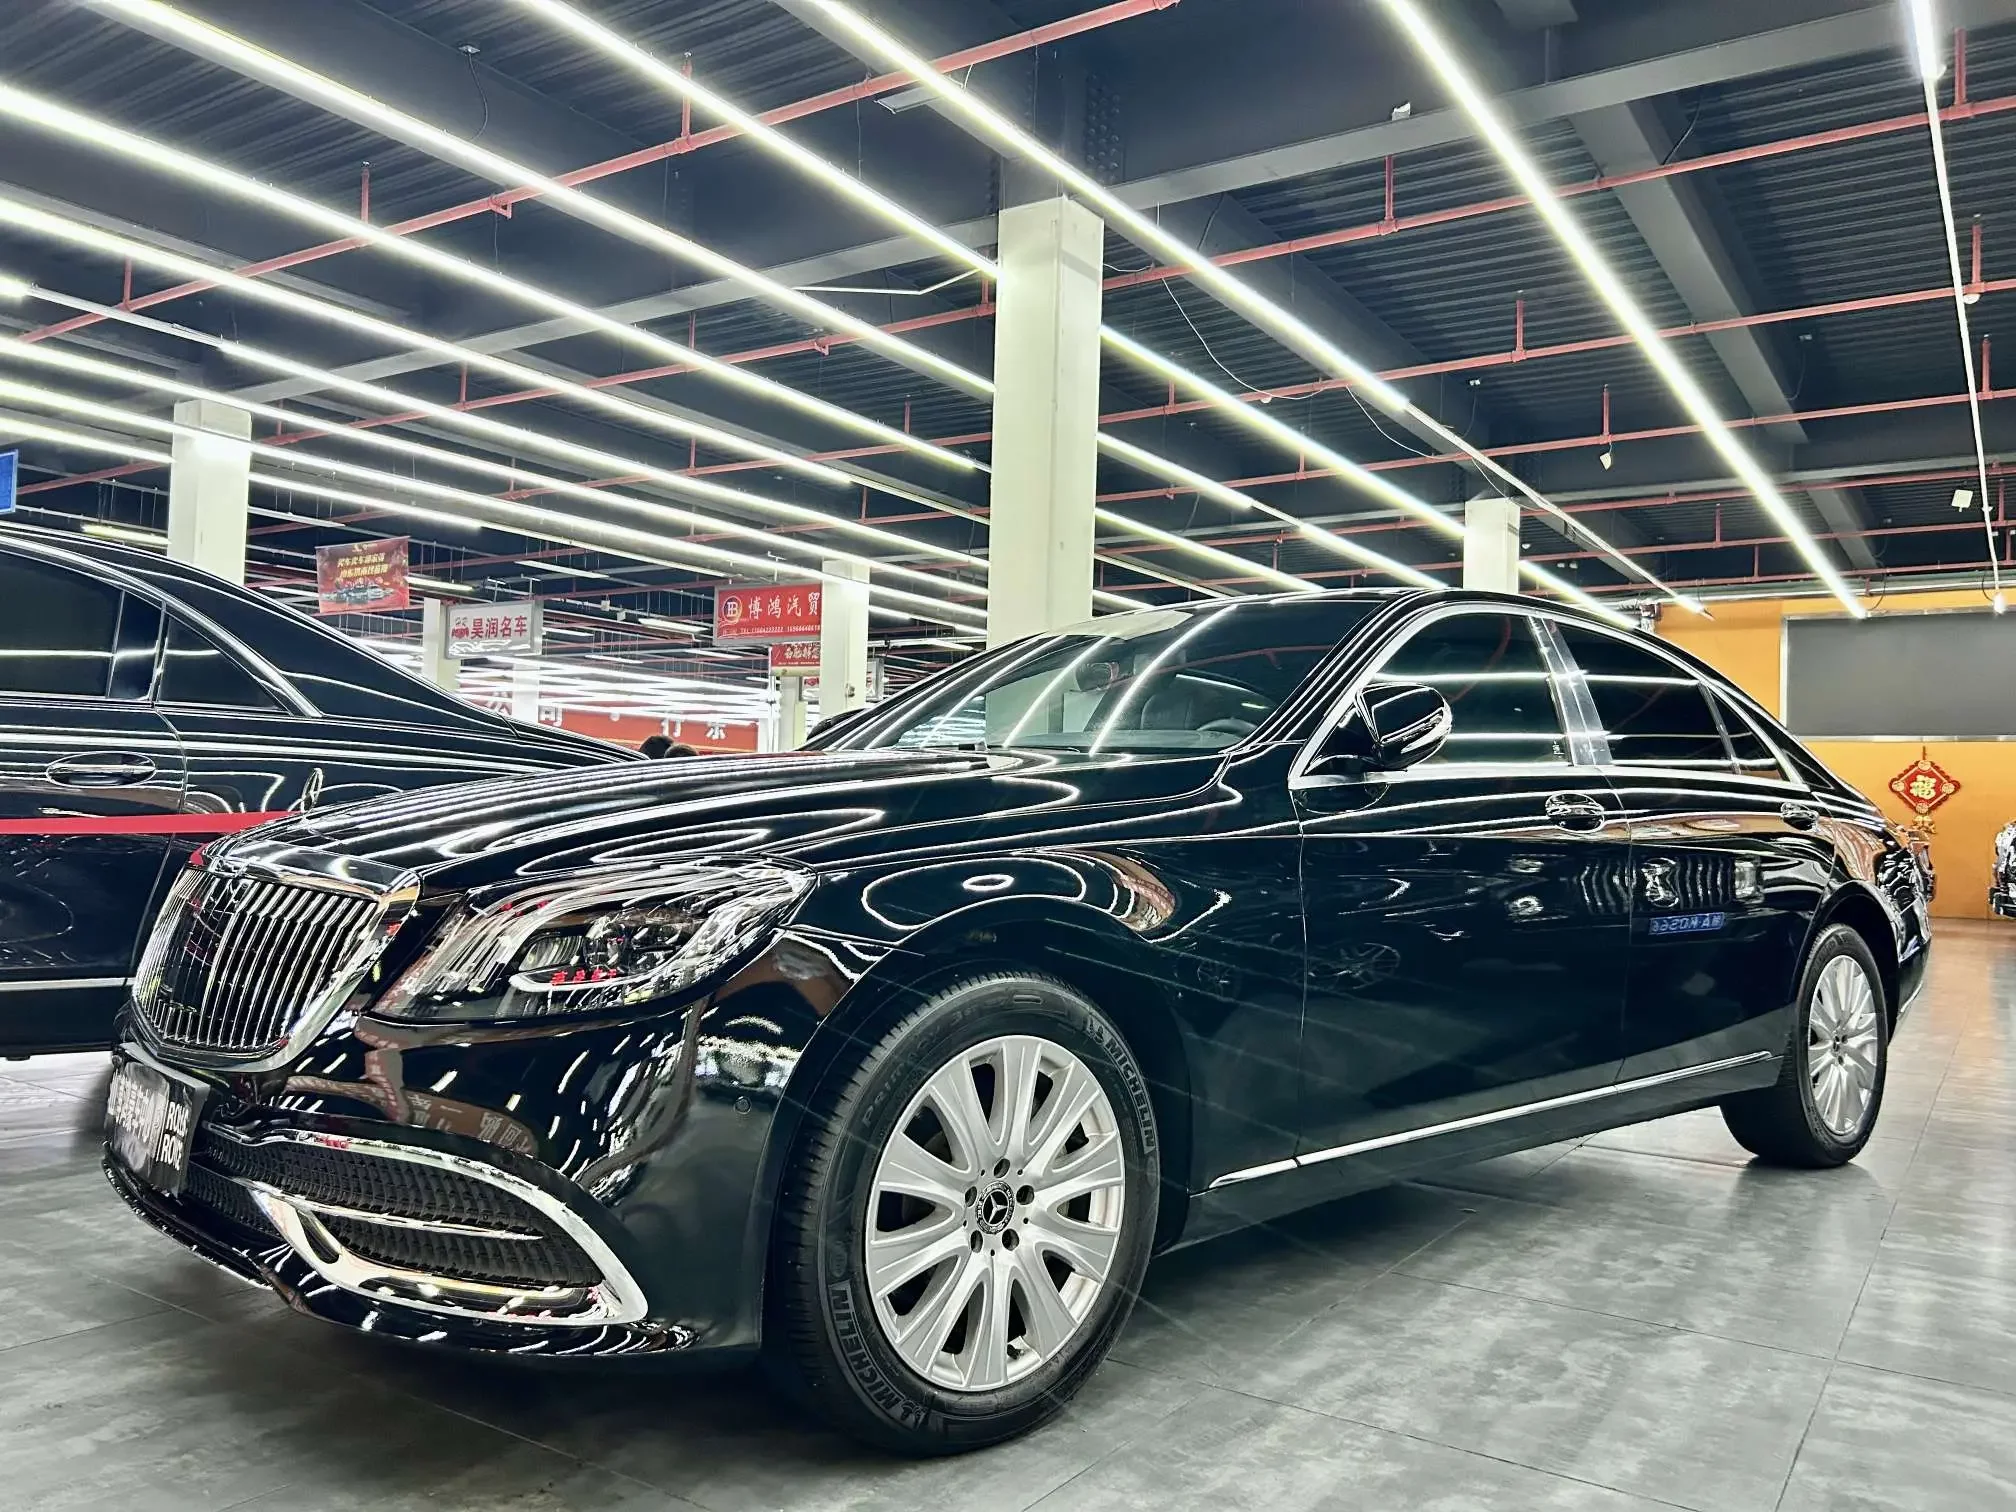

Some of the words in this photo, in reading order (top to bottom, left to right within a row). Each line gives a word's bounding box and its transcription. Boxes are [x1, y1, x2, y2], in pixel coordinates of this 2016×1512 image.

[471, 615, 527, 640] 昊润名车
[1105, 1036, 1155, 1147] MICHELIN
[831, 1289, 901, 1411] MICHELIN
